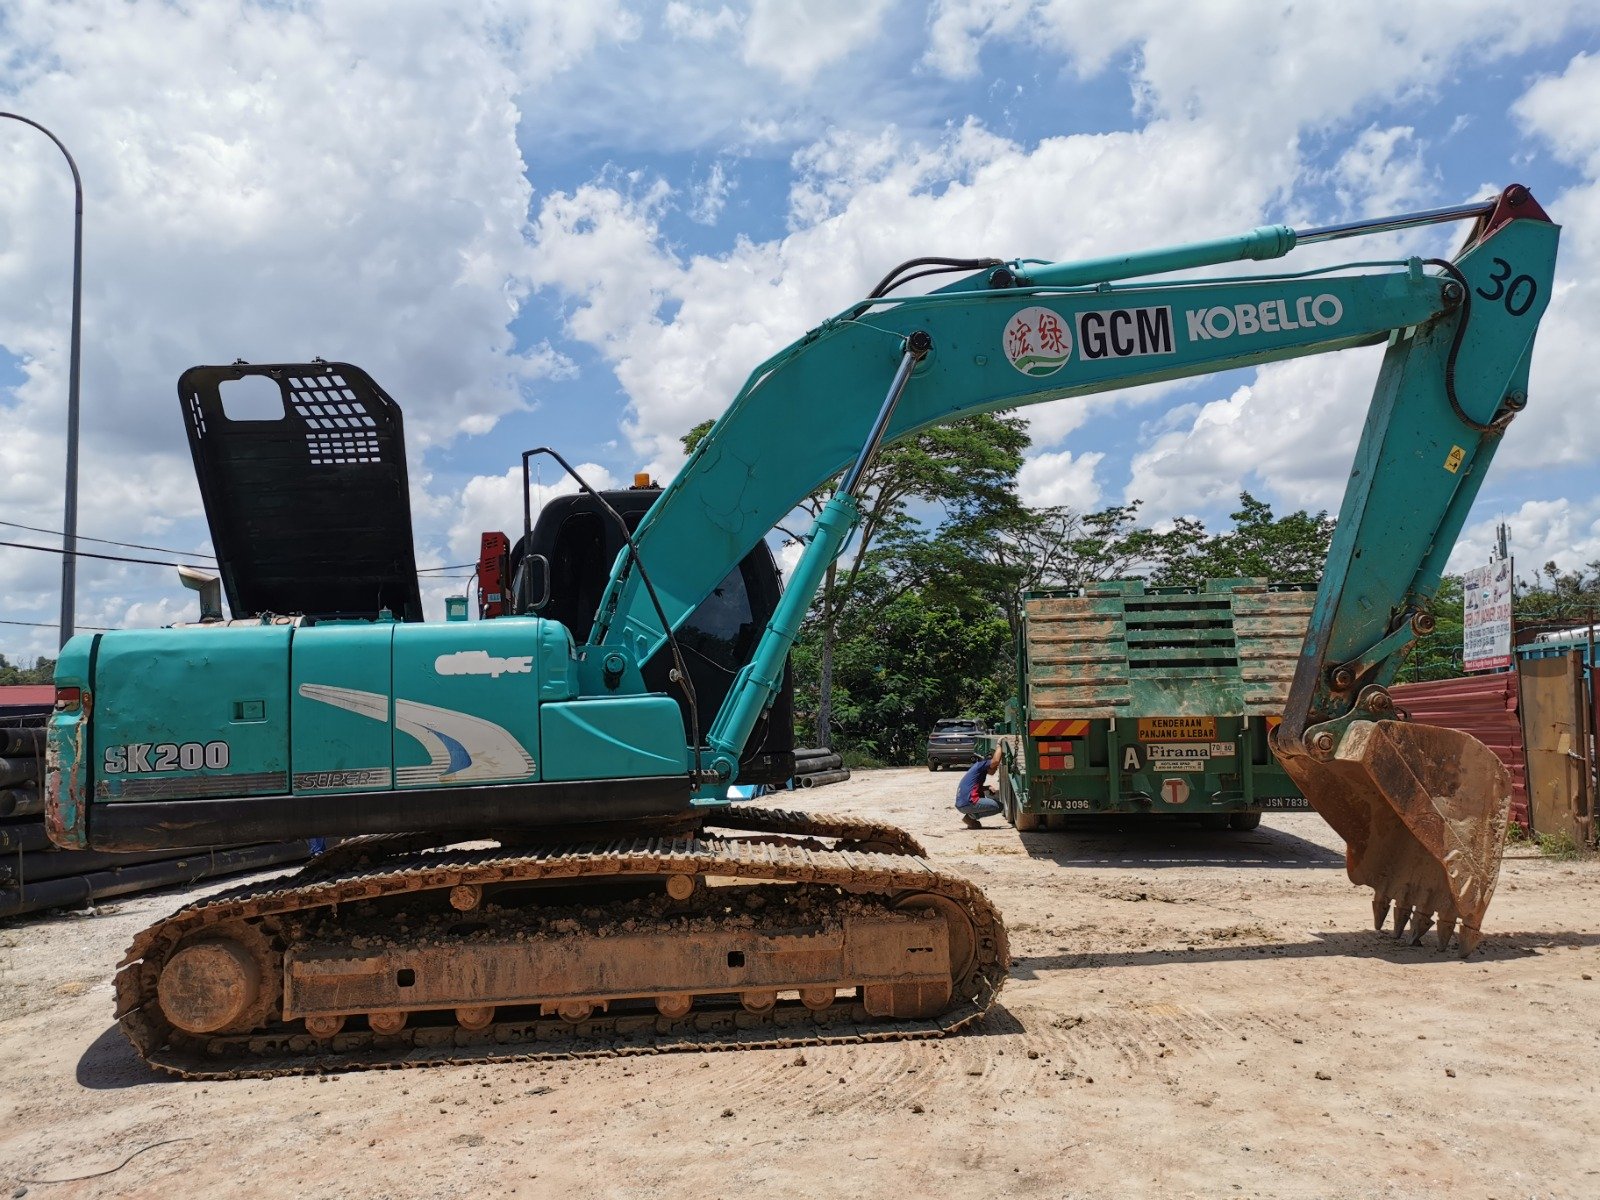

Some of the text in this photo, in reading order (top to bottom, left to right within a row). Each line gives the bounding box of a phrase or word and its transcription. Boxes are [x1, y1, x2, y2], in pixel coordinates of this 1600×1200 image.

[1475, 257, 1538, 317] 30
[1185, 293, 1344, 342] KOBELCO
[1080, 307, 1172, 359] GCM
[1140, 729, 1214, 738] PANJANG & LEBAR
[1152, 719, 1202, 728] KENDERAAN
[104, 741, 229, 774] SK200
[1123, 747, 1141, 770] A
[1148, 745, 1209, 757] Firama
[300, 771, 371, 789] SUPER
[1165, 780, 1183, 803] T
[1042, 800, 1089, 809] T/JA 3096
[1266, 798, 1309, 807] JSN 7838
